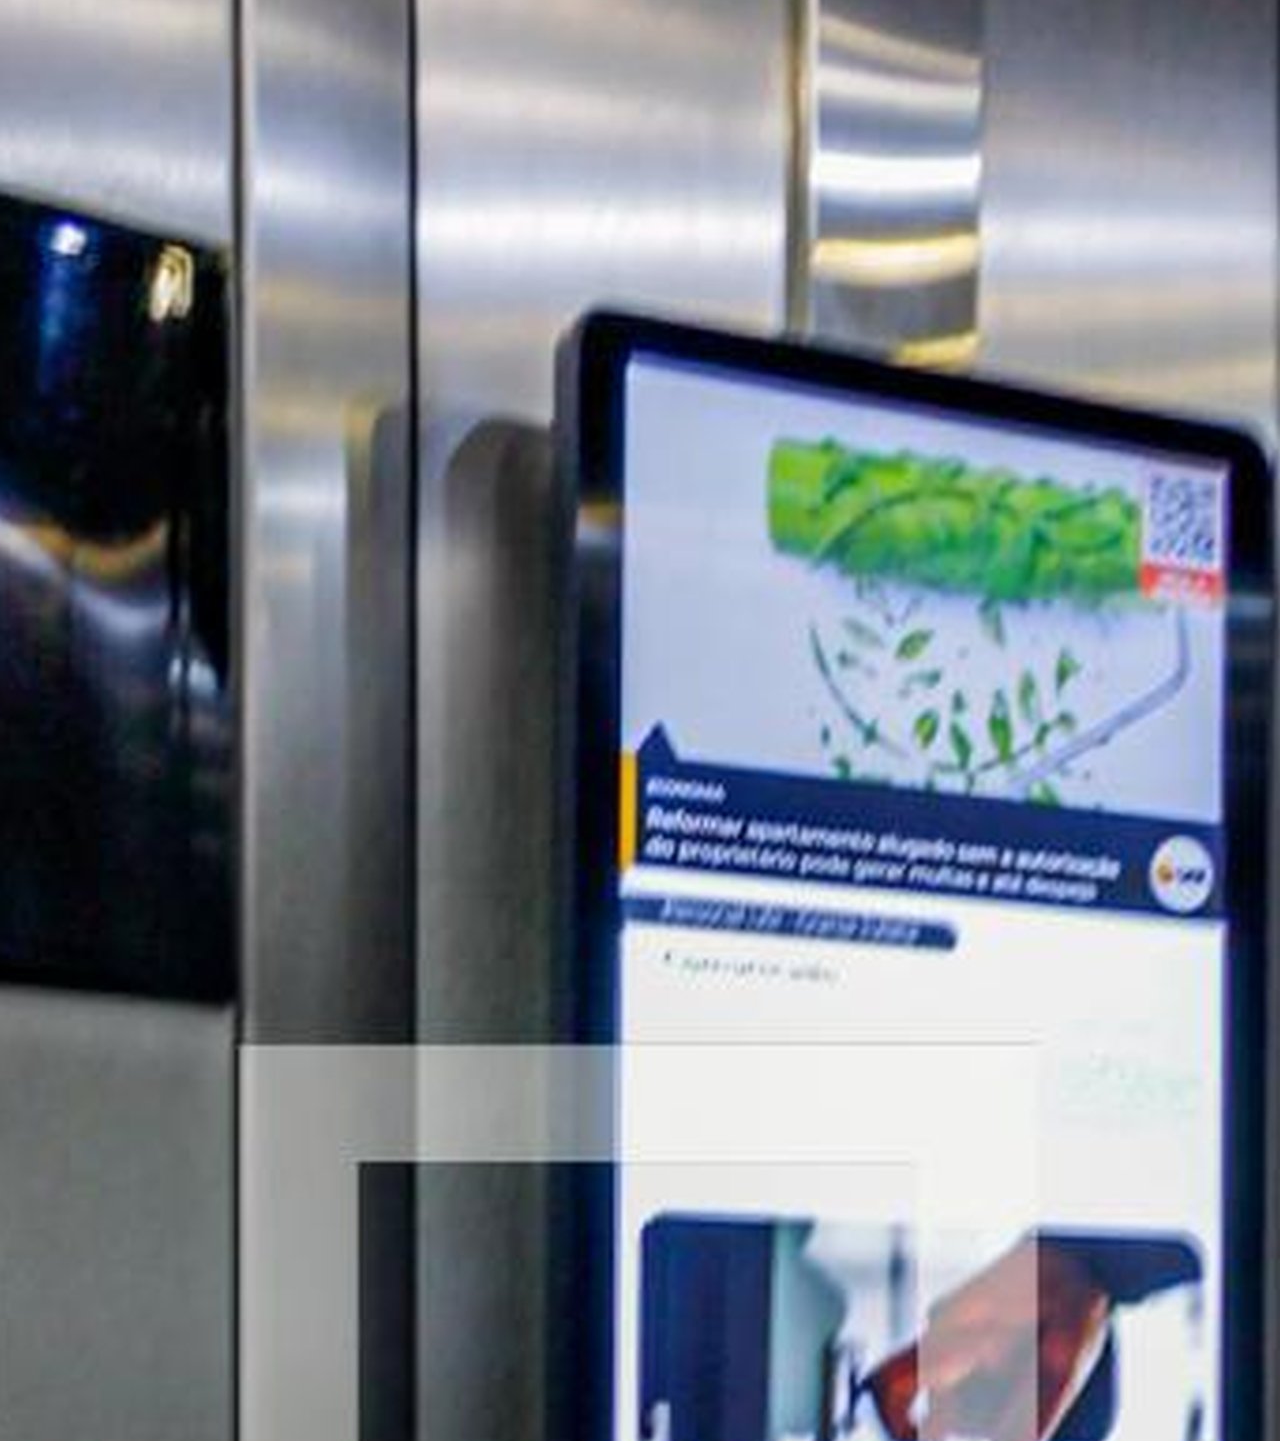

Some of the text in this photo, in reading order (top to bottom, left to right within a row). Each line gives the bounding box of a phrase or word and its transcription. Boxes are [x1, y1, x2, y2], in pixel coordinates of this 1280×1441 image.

[645, 835, 675, 859] do
[677, 840, 798, 872] proprietário
[799, 853, 851, 878] pode
[853, 860, 906, 884] gerar
[646, 806, 744, 838] Reformar
[746, 819, 875, 852] apartamento
[878, 832, 955, 862] alugado
[957, 841, 998, 864] sem
